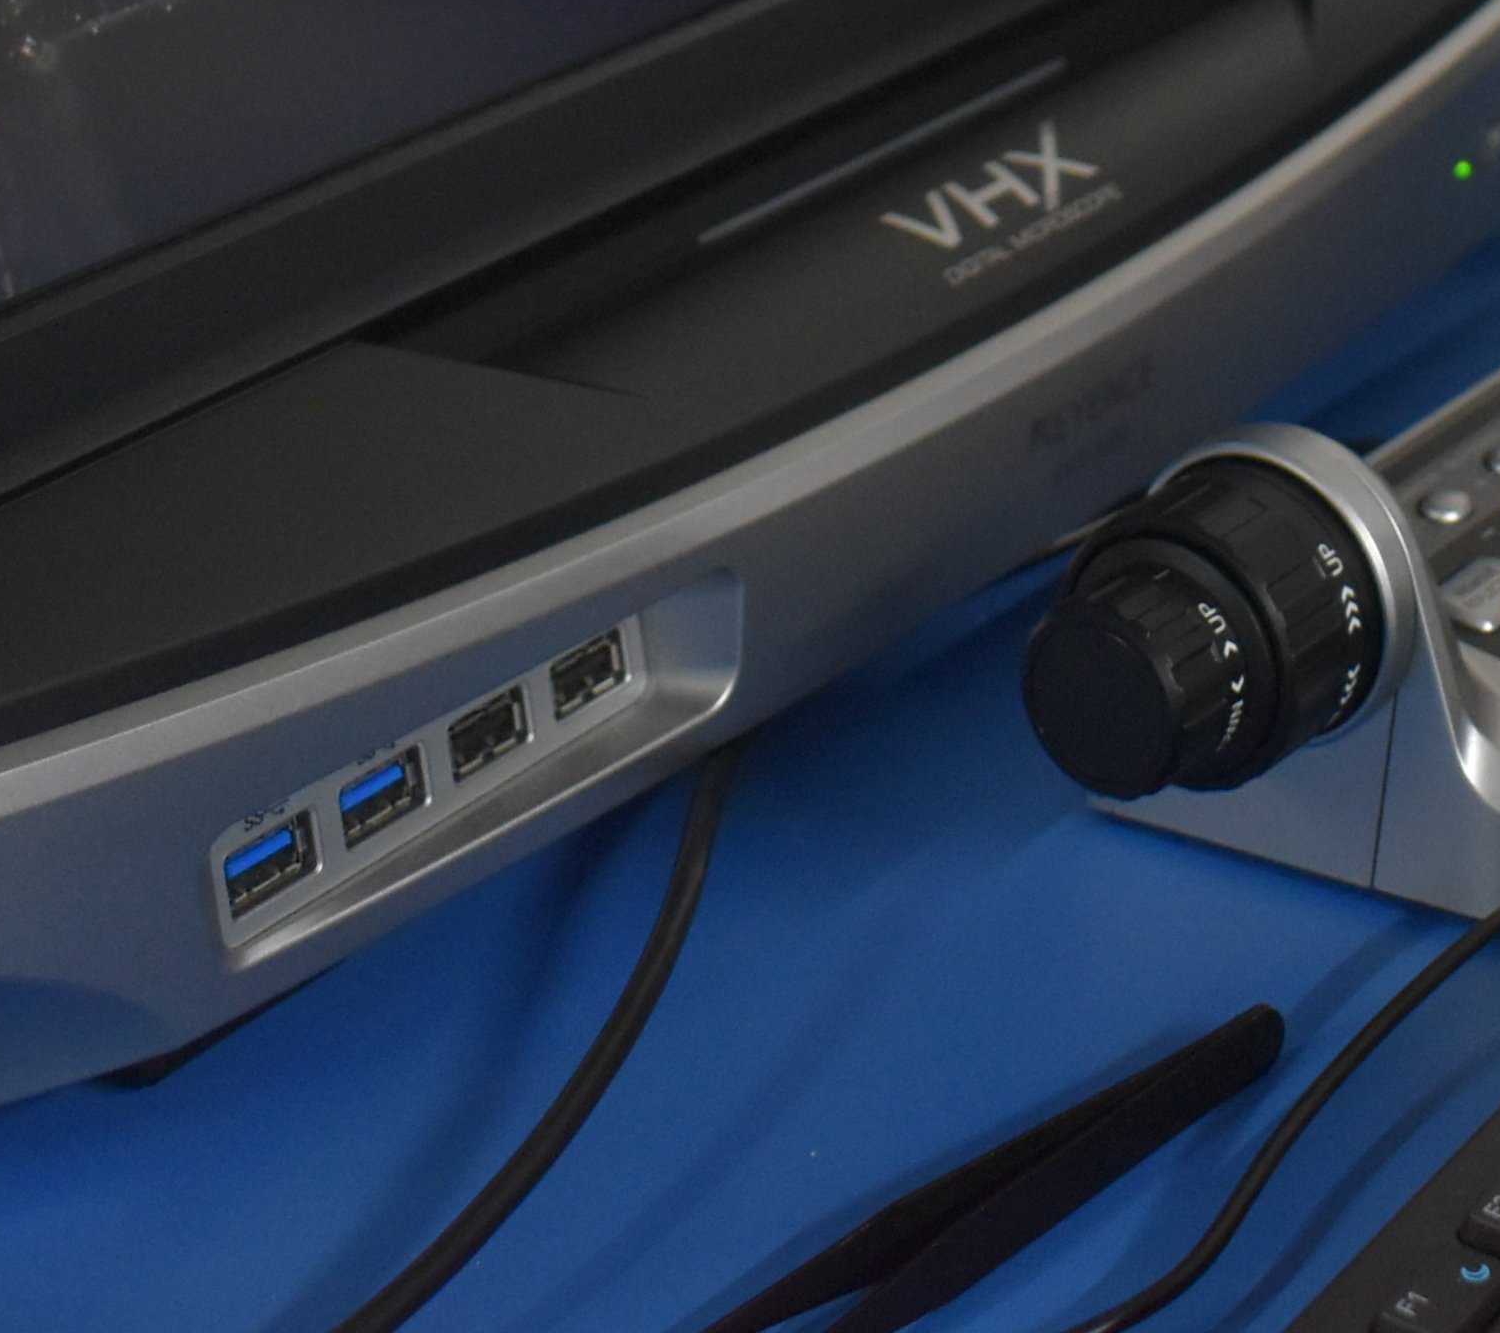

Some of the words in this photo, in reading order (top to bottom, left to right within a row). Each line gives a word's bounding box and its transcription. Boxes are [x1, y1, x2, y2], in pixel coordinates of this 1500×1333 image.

[880, 119, 1100, 250] VHX
[1317, 542, 1344, 577] UP
[1198, 602, 1226, 633] UP
[1395, 1291, 1428, 1316] F1
